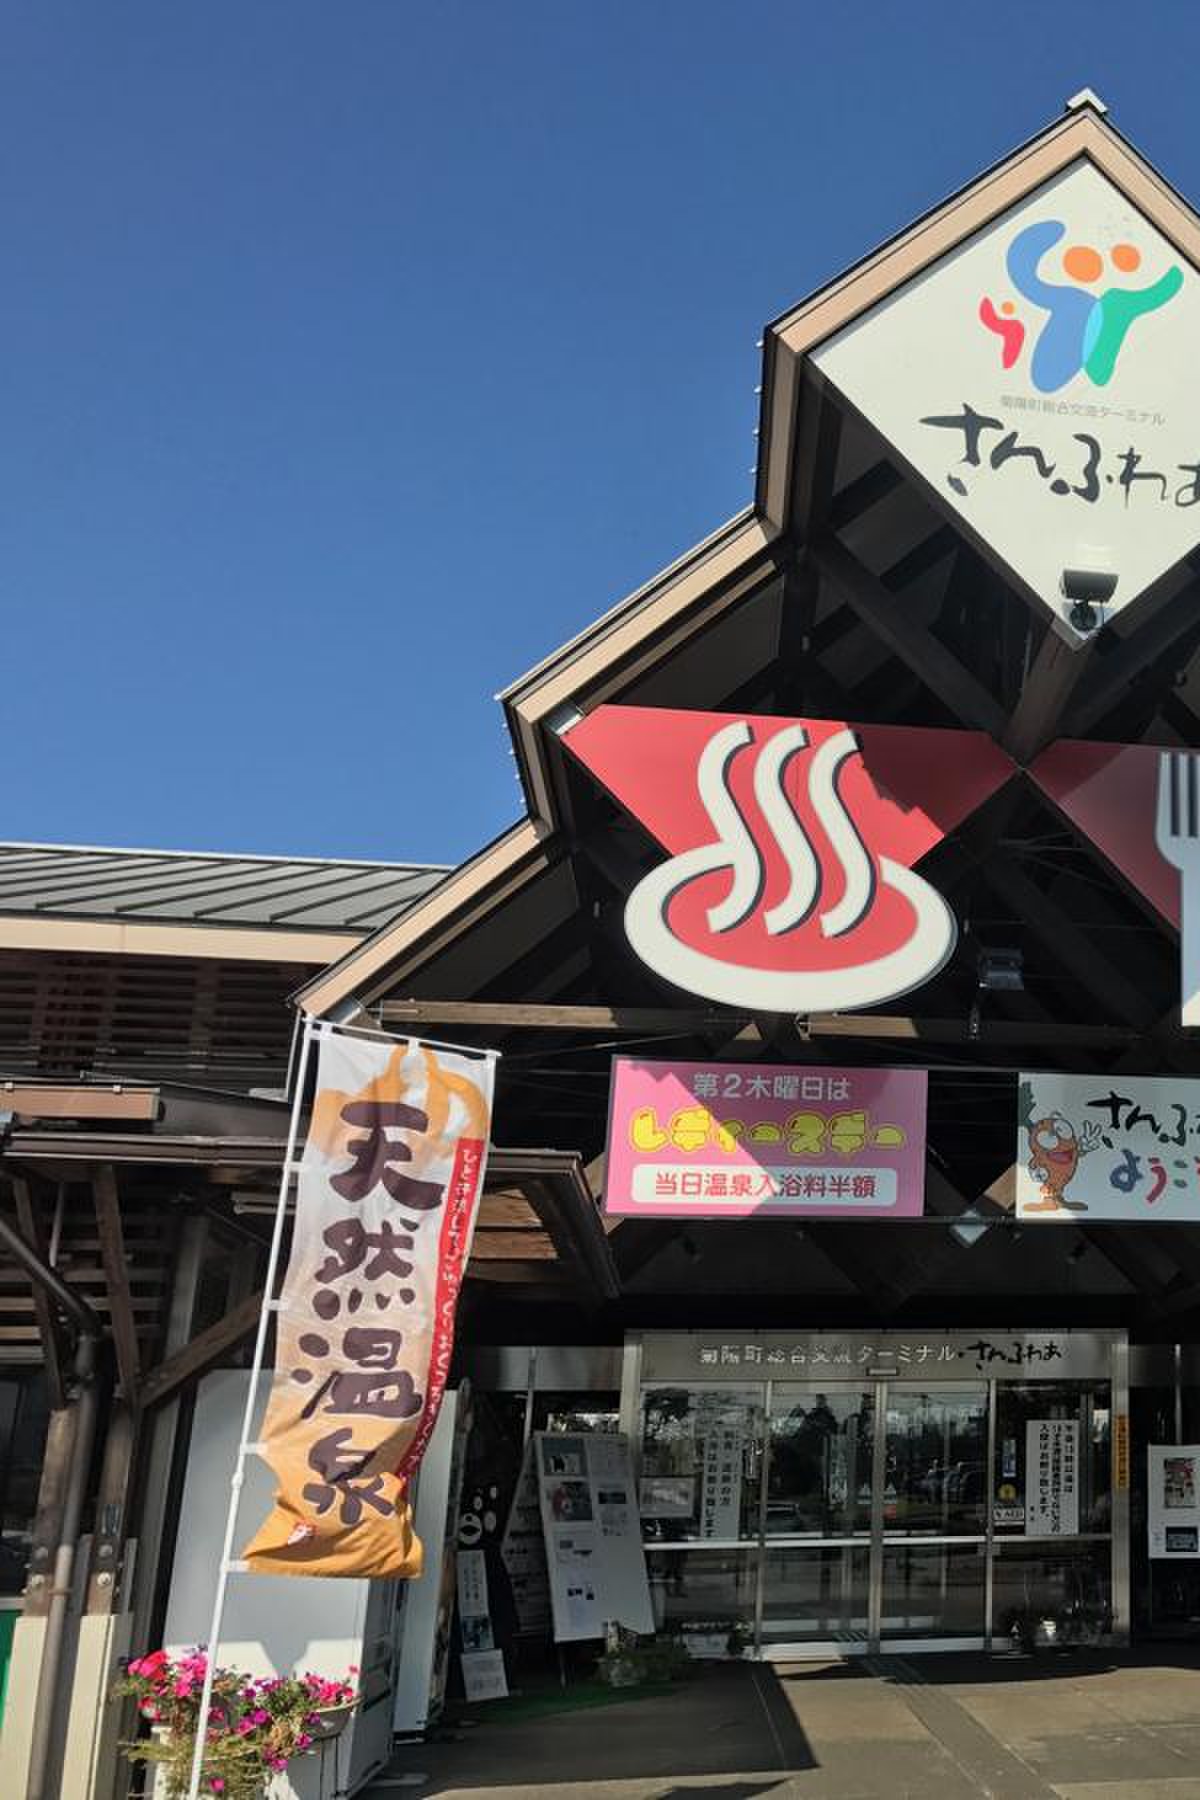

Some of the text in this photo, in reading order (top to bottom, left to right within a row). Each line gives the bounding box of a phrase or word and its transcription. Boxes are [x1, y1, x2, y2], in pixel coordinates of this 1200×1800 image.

[693, 1072, 851, 1101] 第2木曜日は
[655, 1172, 876, 1199] 当日温泉入浴料半額
[289, 1100, 447, 1526] 天然温泉
